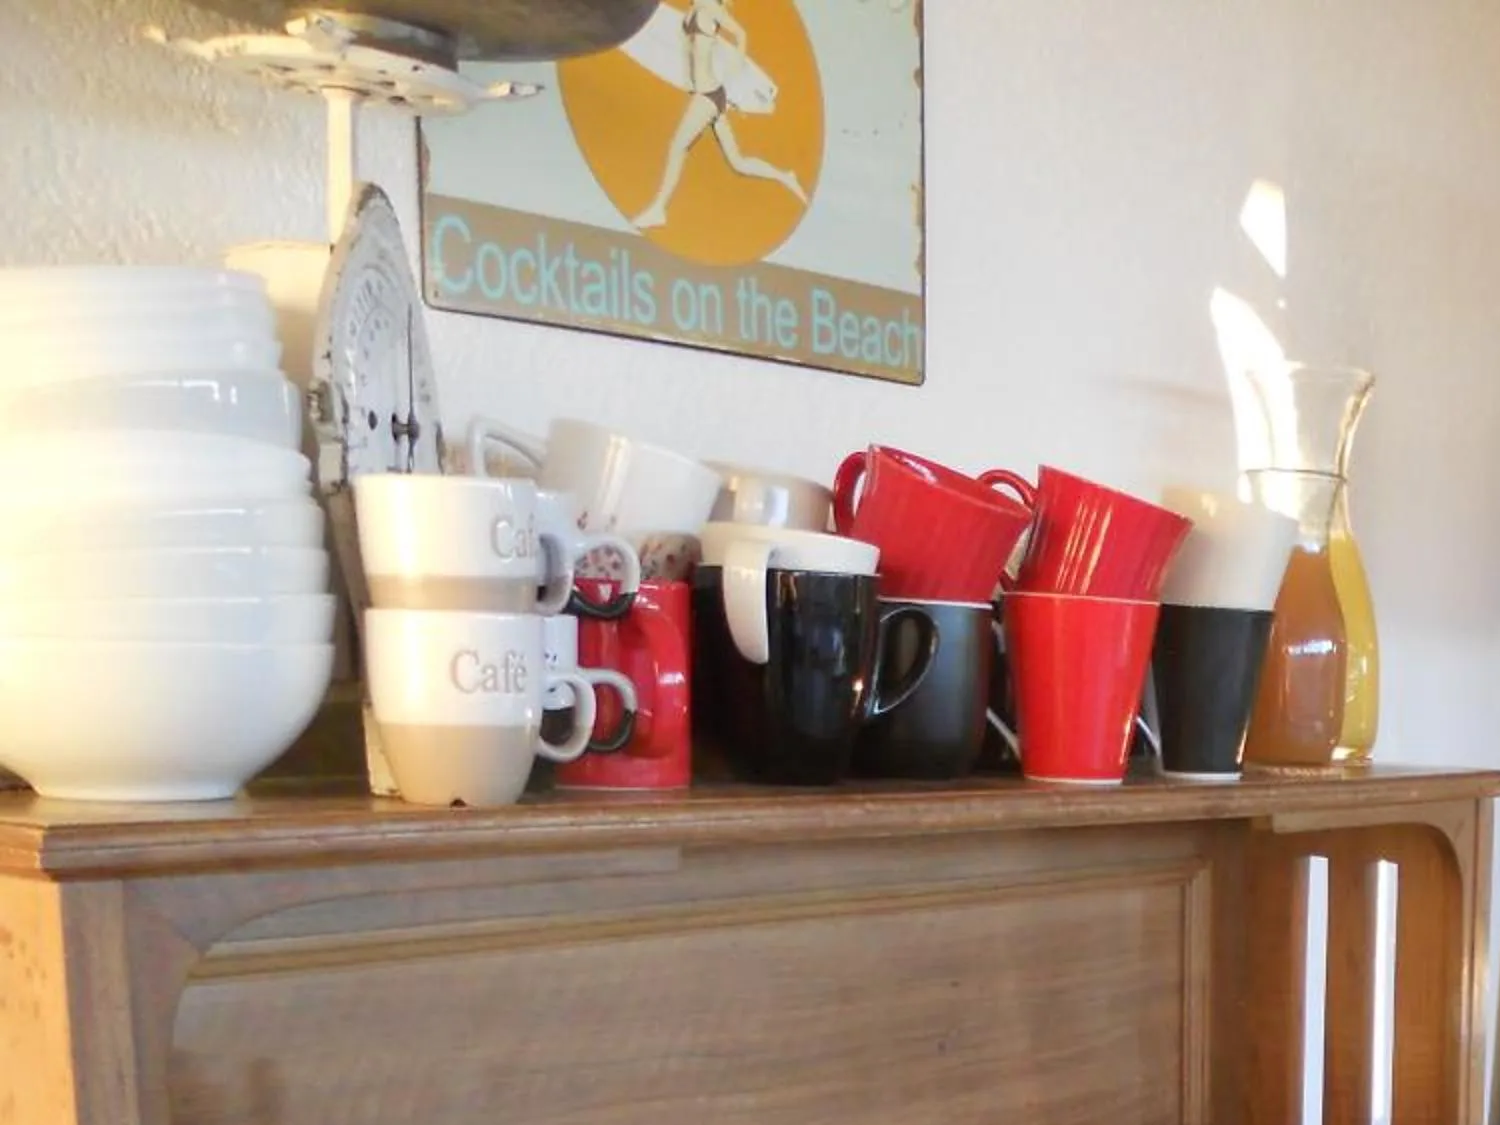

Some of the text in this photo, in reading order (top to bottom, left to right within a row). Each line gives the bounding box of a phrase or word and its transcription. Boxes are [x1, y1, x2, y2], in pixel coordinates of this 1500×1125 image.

[429, 214, 922, 369] Cocktails on the Beach
[450, 647, 528, 695] Café
